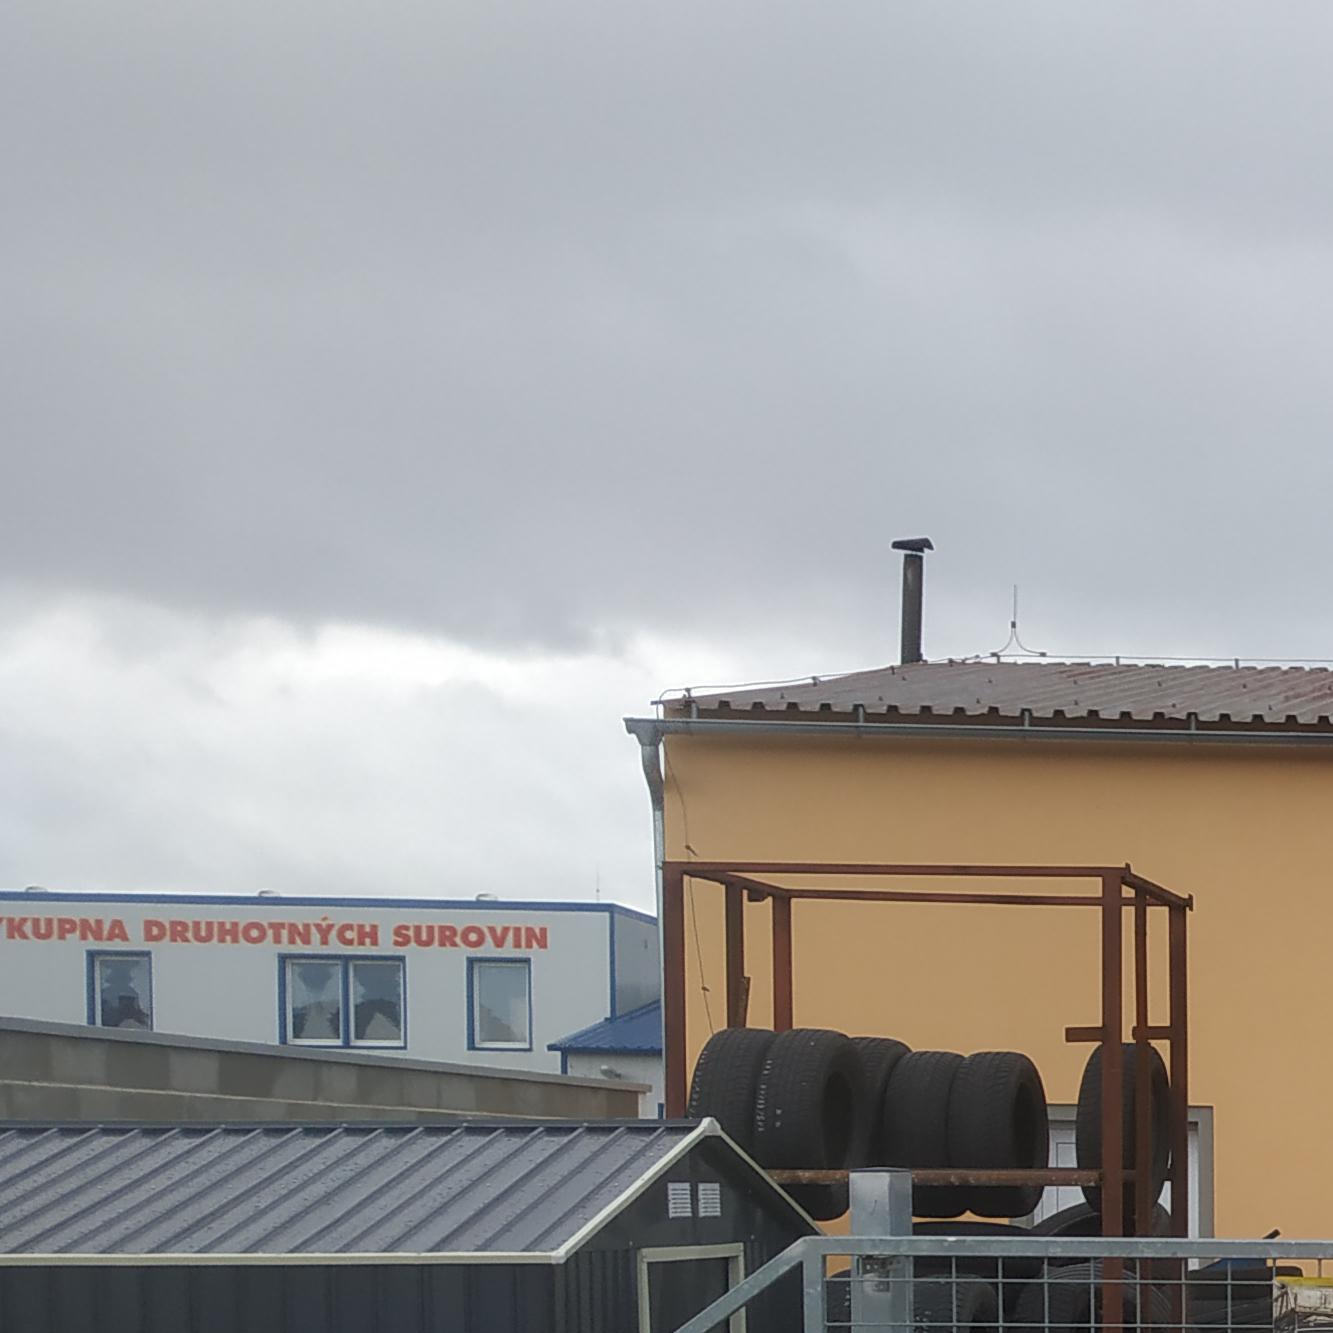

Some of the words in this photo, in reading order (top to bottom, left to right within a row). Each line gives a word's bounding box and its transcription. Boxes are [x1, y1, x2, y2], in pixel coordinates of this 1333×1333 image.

[0, 916, 130, 942] KUPNA
[143, 916, 379, 946] DRUHOTNÝCH
[392, 924, 549, 949] SUROVIN
